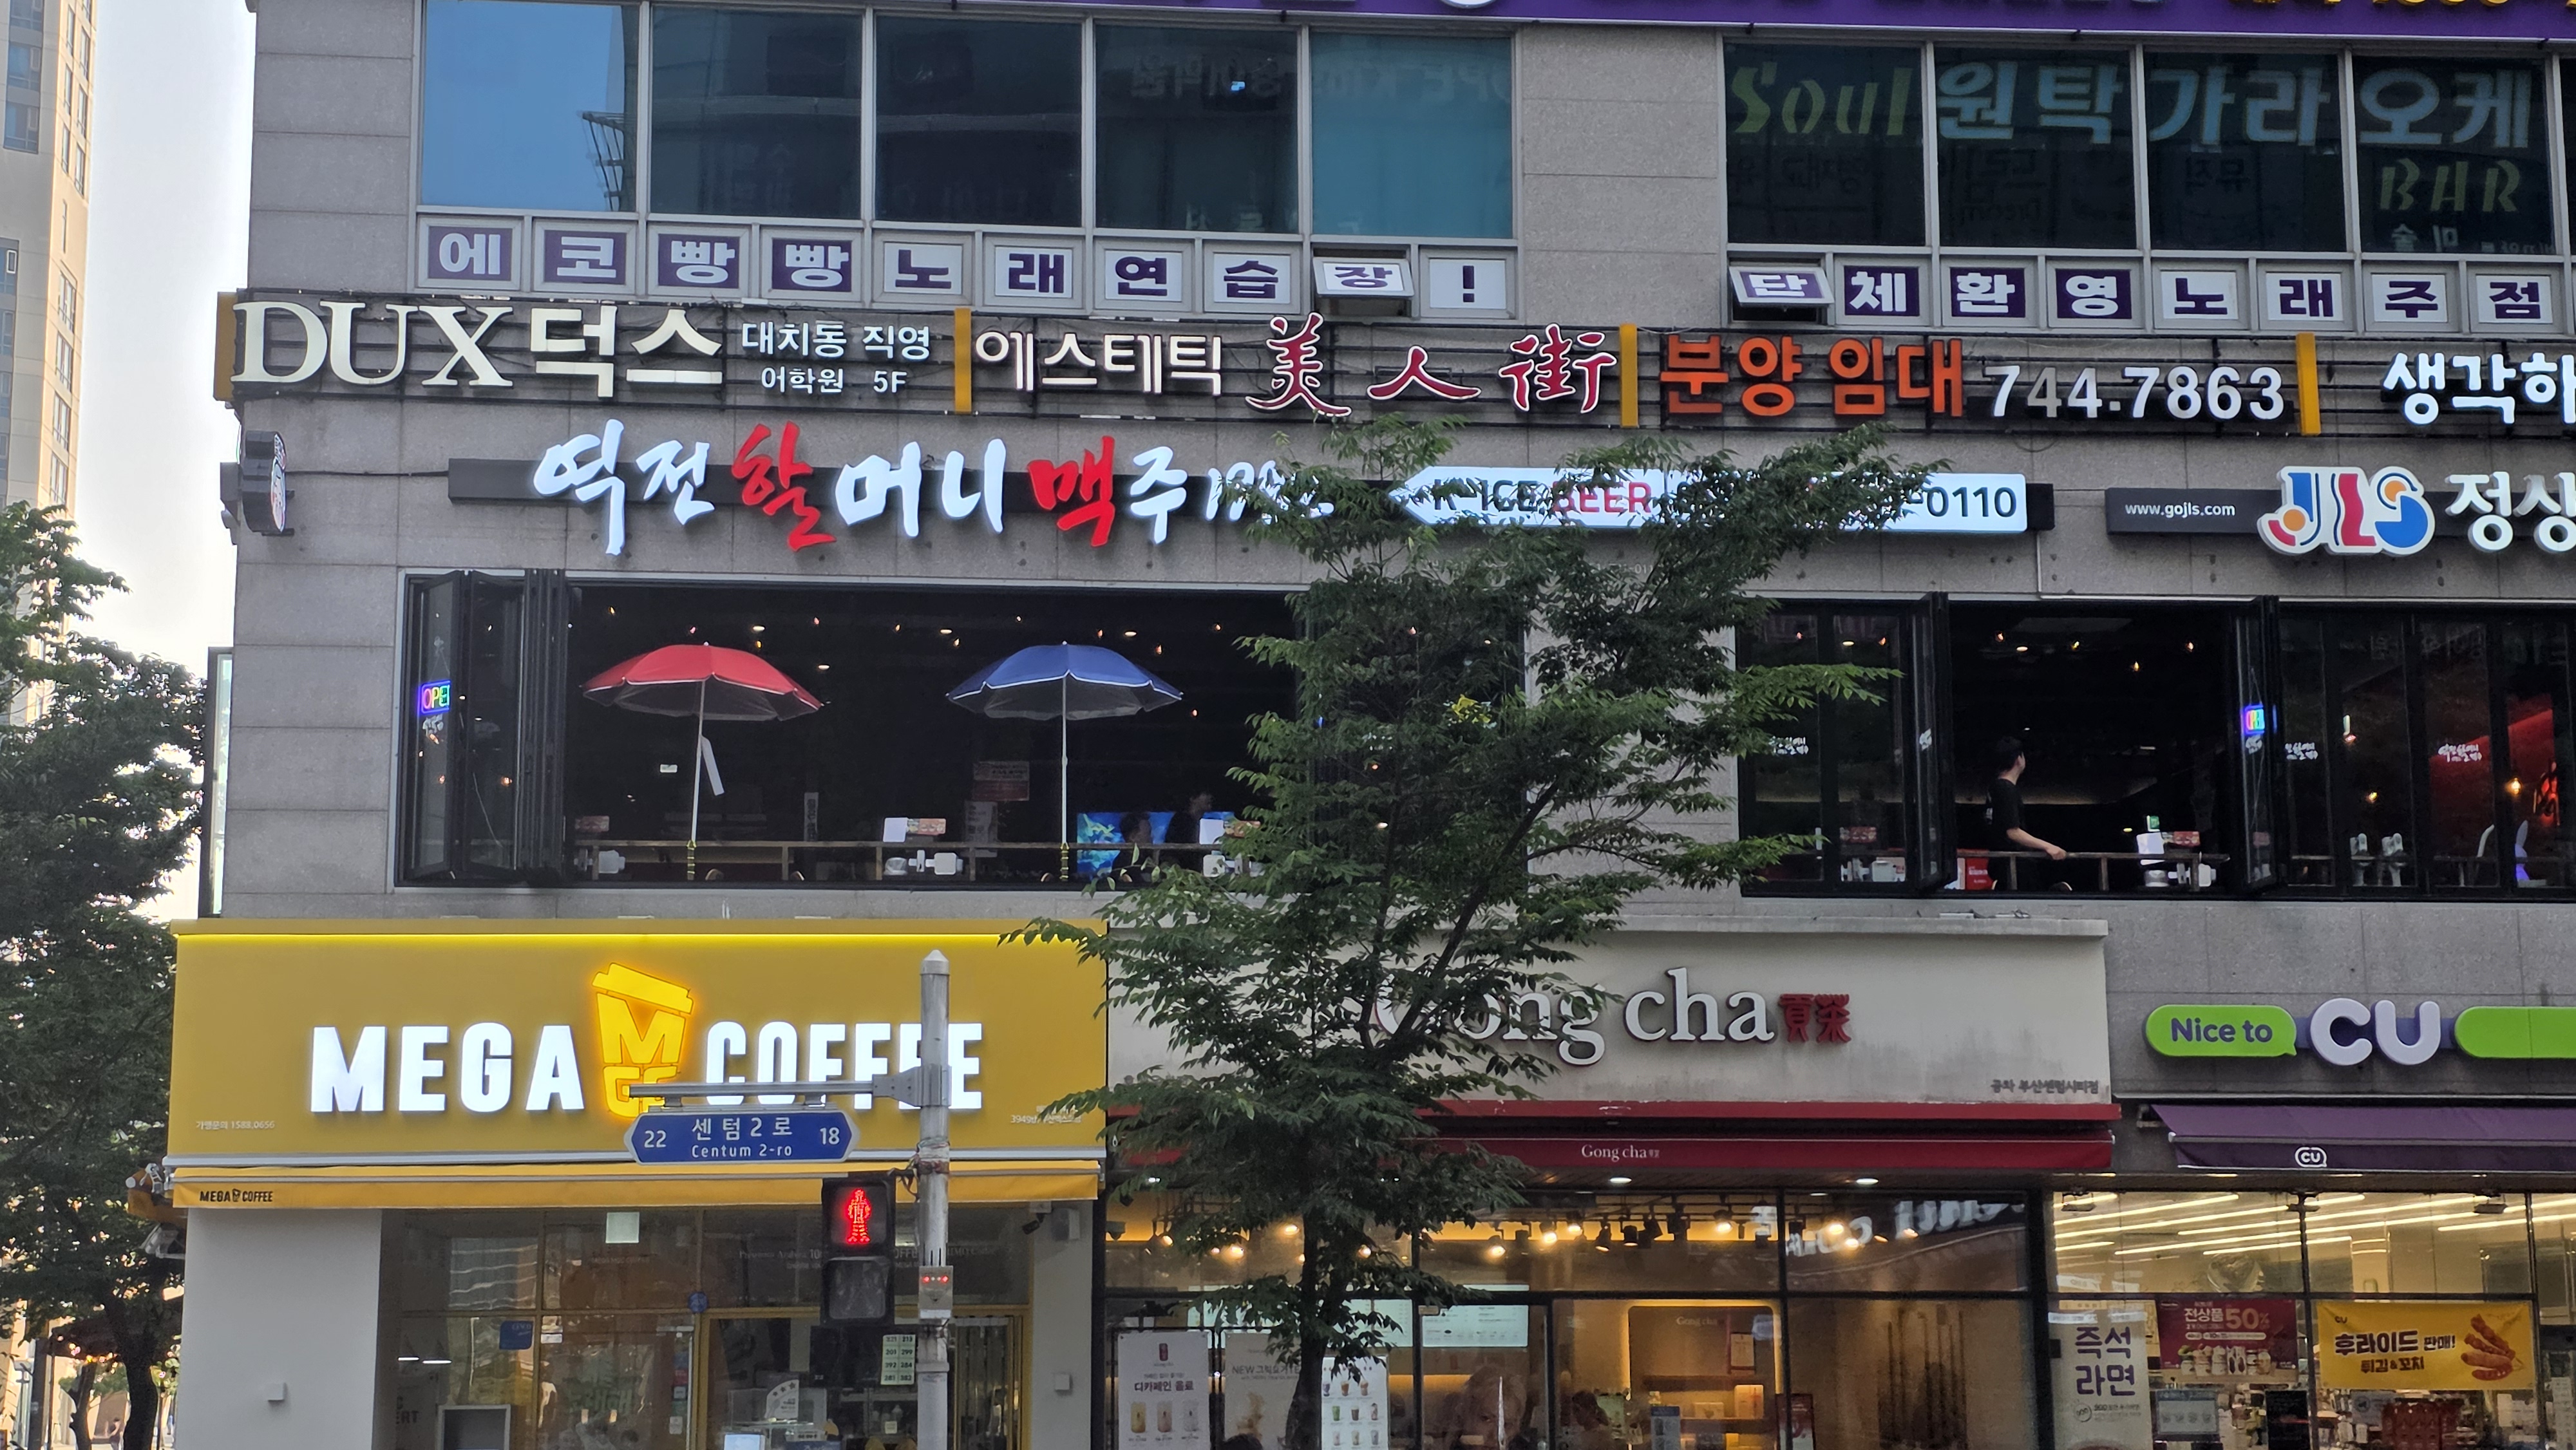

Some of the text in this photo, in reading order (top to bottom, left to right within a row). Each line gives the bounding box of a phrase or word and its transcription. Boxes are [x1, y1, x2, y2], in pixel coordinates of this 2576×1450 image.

[1730, 62, 1913, 136] Soul
[231, 301, 723, 398] DUX 덕스
[743, 321, 931, 361] 대치동 직영
[974, 330, 1222, 396] 에스테틱
[762, 366, 907, 393] 어학원 5F
[1661, 335, 2285, 420] 분양 임대 744.7863
[2125, 502, 2235, 519] www.gojls.com
[422, 684, 450, 710] OPE
[1624, 967, 1775, 1043] cha
[2171, 1017, 2273, 1043] Nice to
[2310, 997, 2442, 1066] CU
[310, 1022, 585, 1112] MEGA
[644, 1130, 667, 1148] 22
[820, 1127, 840, 1145] 18
[692, 1144, 793, 1158] Centum 2-ro
[1581, 1144, 1620, 1163] Gong
[1622, 1144, 1647, 1158] cha
[2302, 1152, 2321, 1163] CU
[200, 1190, 274, 1202] MEGA COFFEE
[2075, 1326, 2131, 1359] 즉석
[2335, 1330, 2456, 1356] 후라이드 판매!
[2076, 1364, 2136, 1396] 라면
